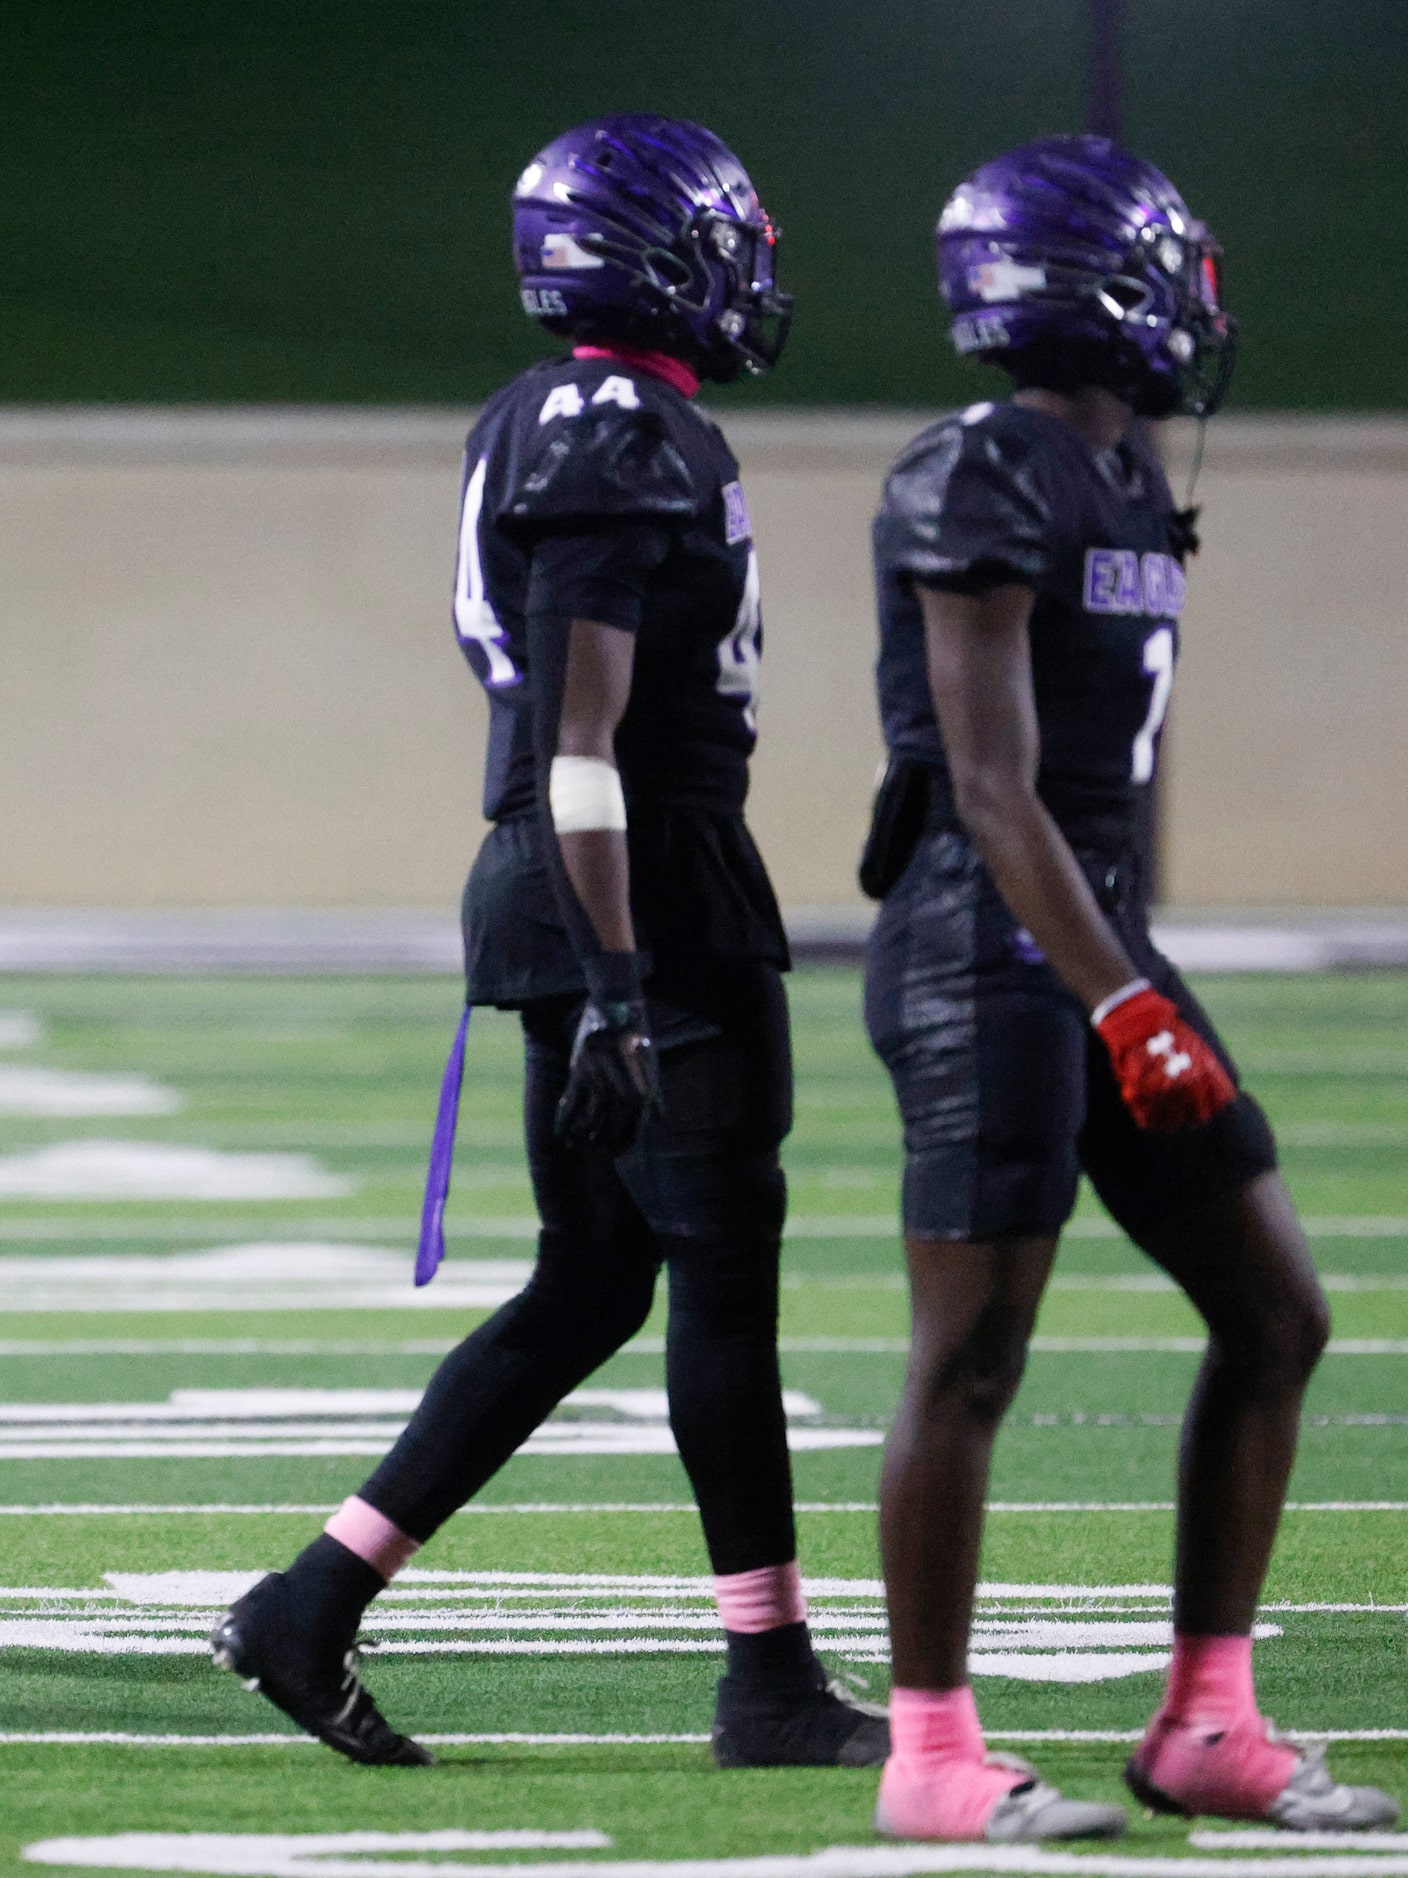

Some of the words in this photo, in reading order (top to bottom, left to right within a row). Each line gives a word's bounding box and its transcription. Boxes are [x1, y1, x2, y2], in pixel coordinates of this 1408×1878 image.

[538, 374, 641, 427] 44
[454, 456, 518, 684] 4
[716, 547, 762, 734] 4
